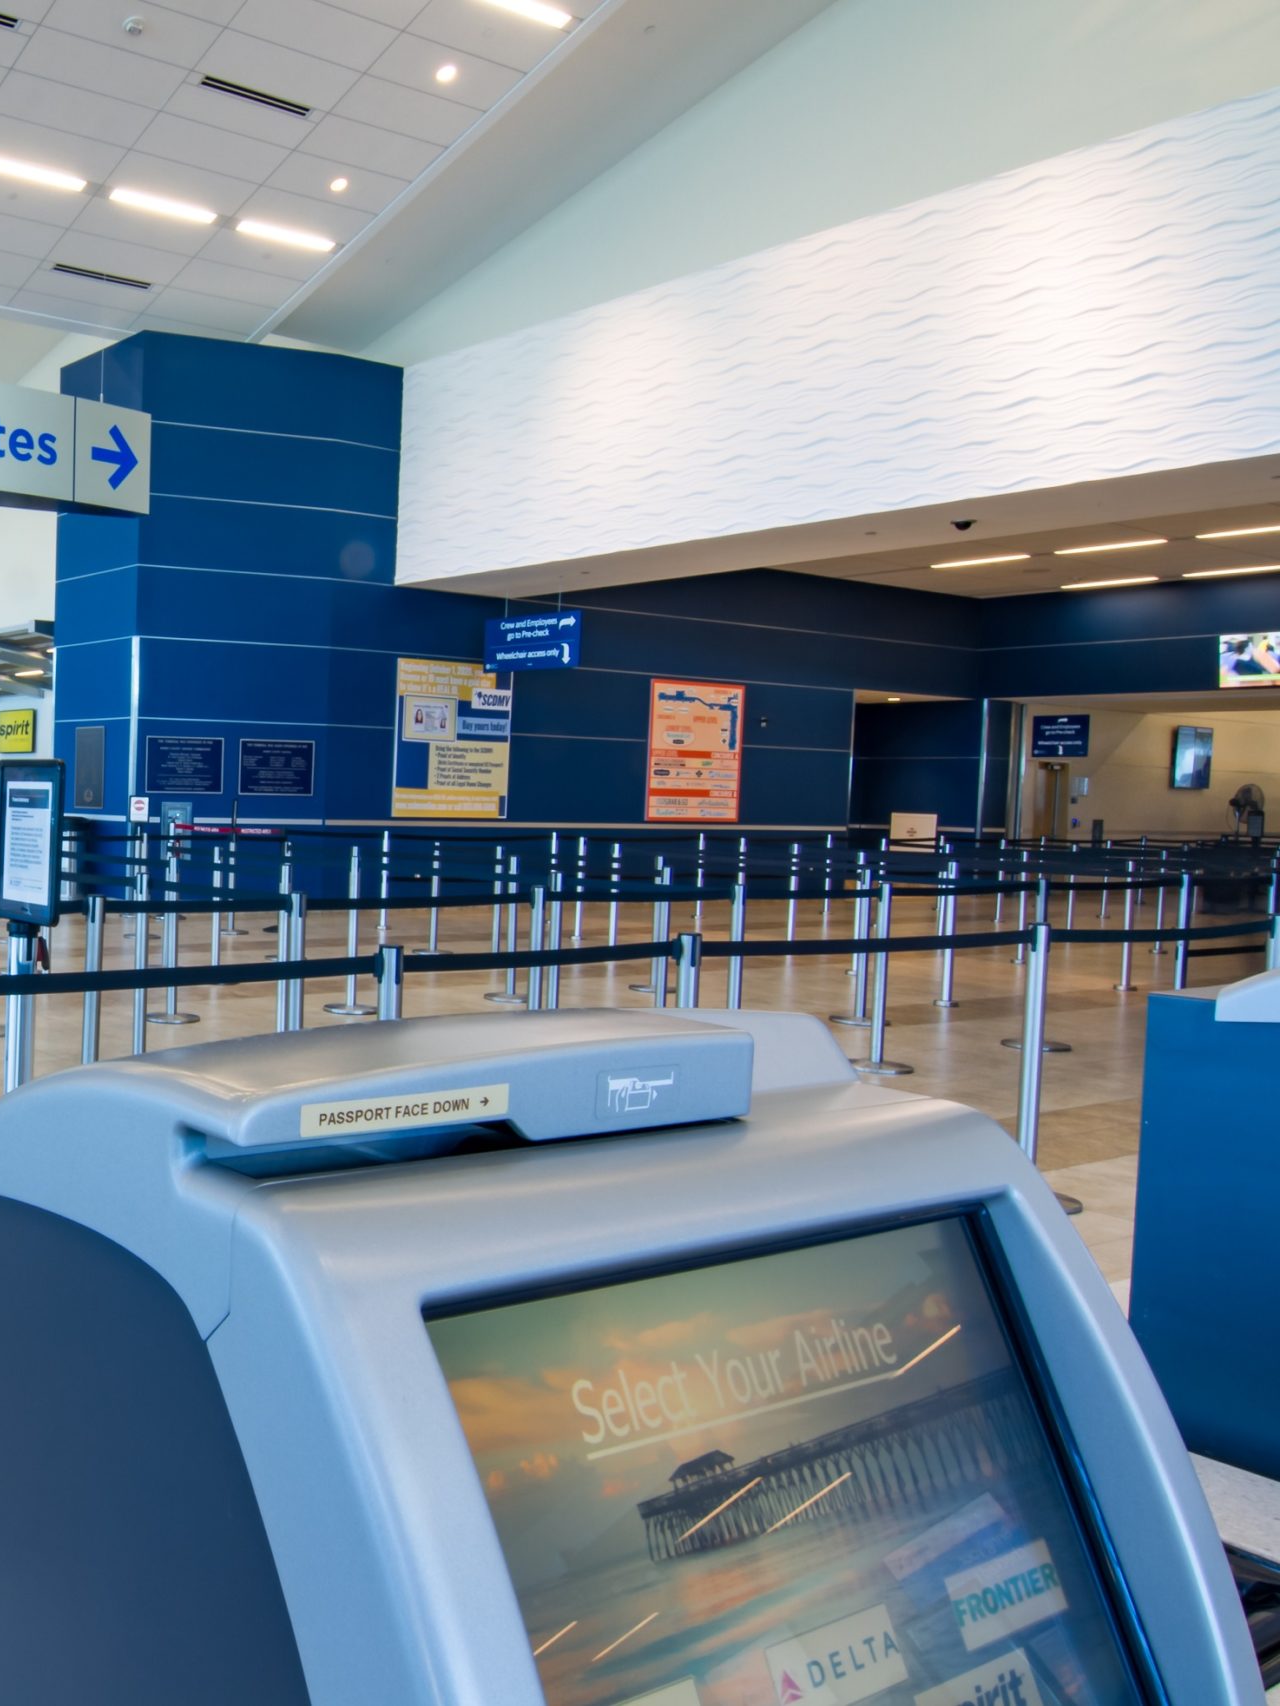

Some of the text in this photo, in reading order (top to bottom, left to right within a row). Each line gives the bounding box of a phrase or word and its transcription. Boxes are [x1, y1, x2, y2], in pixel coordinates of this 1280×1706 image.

[500, 617, 558, 630] Crew and Employees
[496, 647, 560, 661] Wheelchair access only
[481, 693, 510, 707] SCDMV
[0, 719, 30, 740] spirit
[318, 1097, 471, 1127] PASSPORT FACE DOWN
[570, 1318, 898, 1445] Select Your Airline
[952, 1562, 1061, 1629] FRONTIER
[806, 1630, 902, 1689] DELTA
